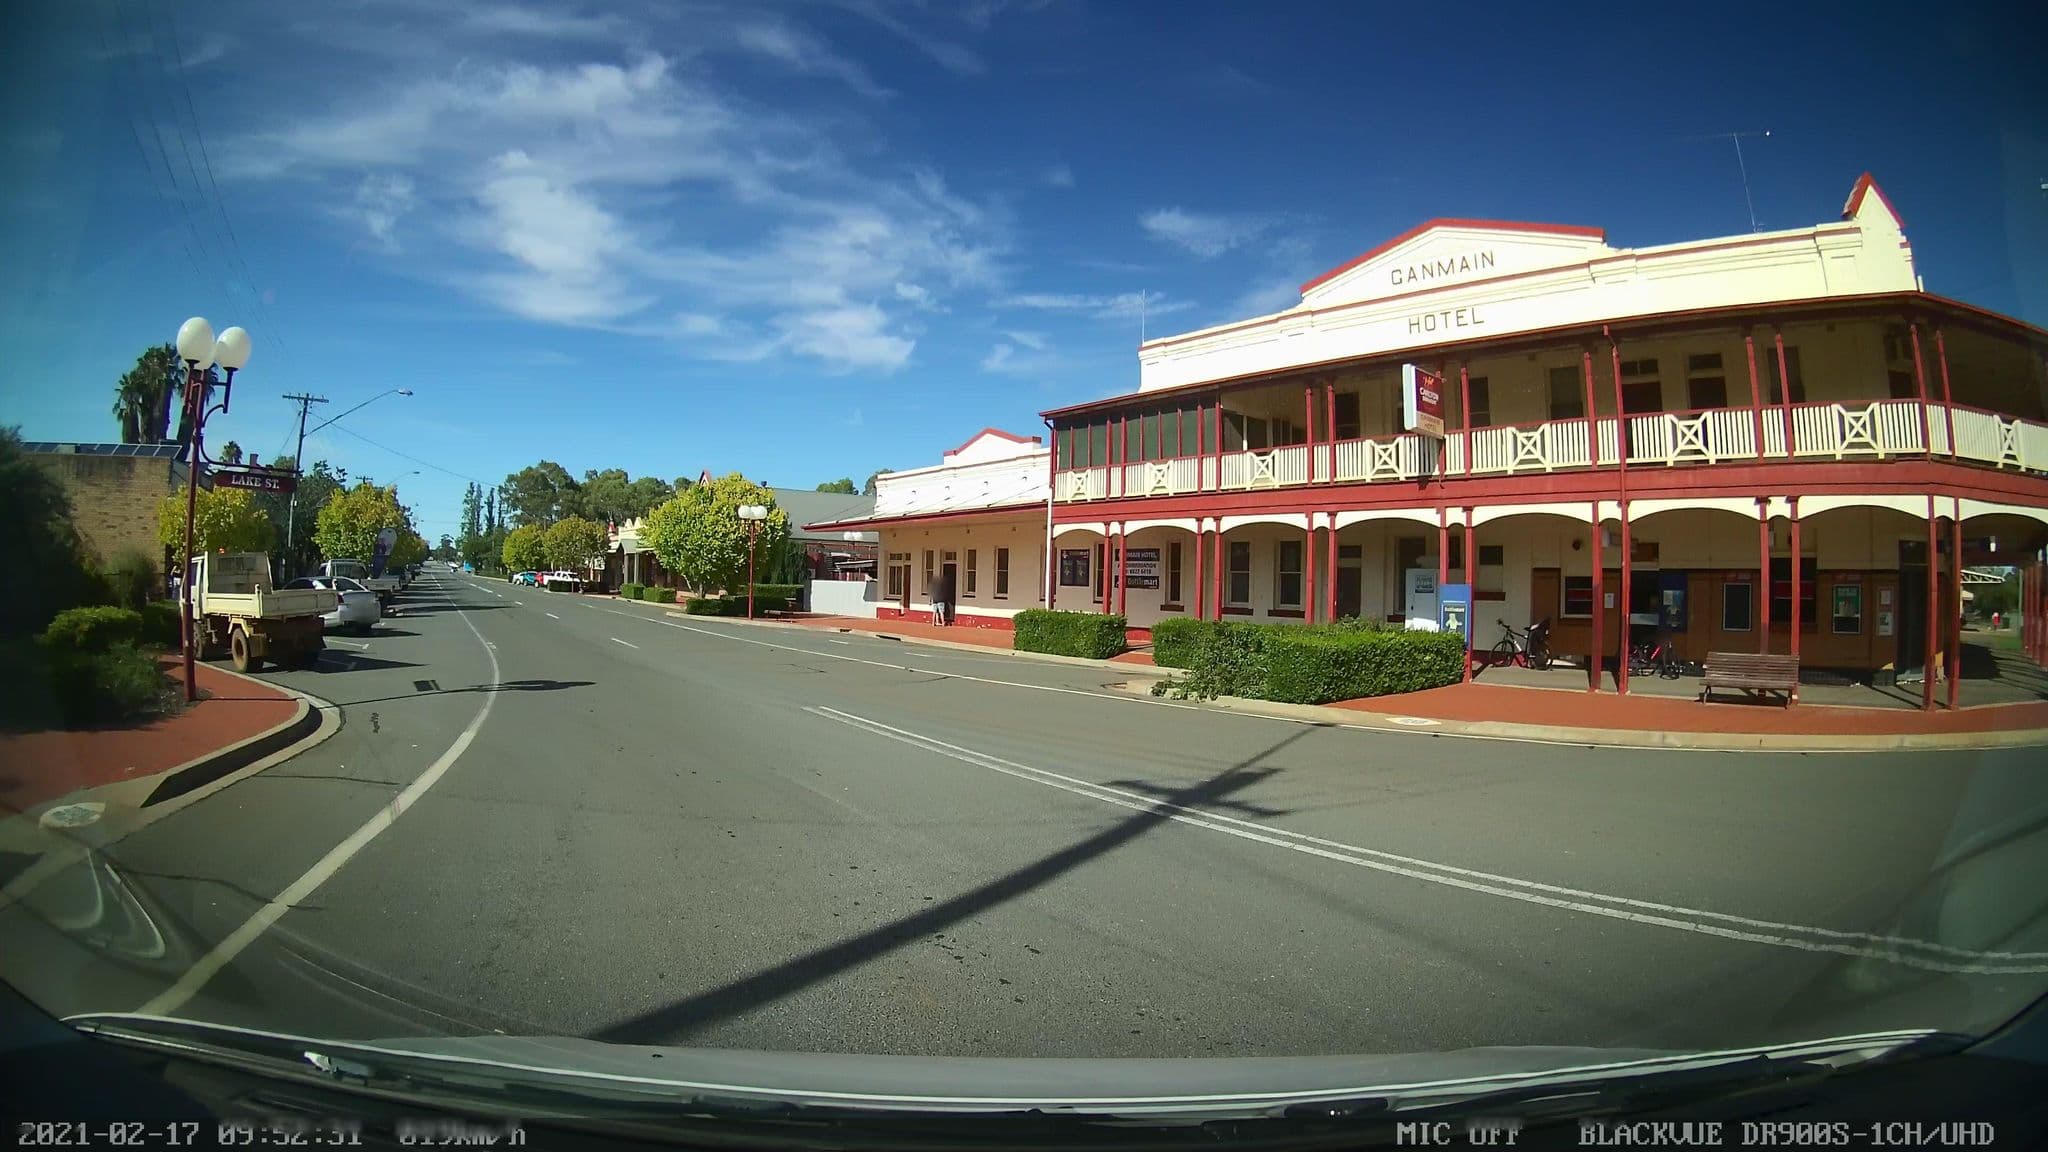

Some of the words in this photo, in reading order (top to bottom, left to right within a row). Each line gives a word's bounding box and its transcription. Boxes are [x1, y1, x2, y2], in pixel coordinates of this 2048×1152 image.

[1391, 250, 1495, 285] GANMAIN
[1408, 307, 1485, 335] HOTEL
[231, 474, 262, 487] LAKE
